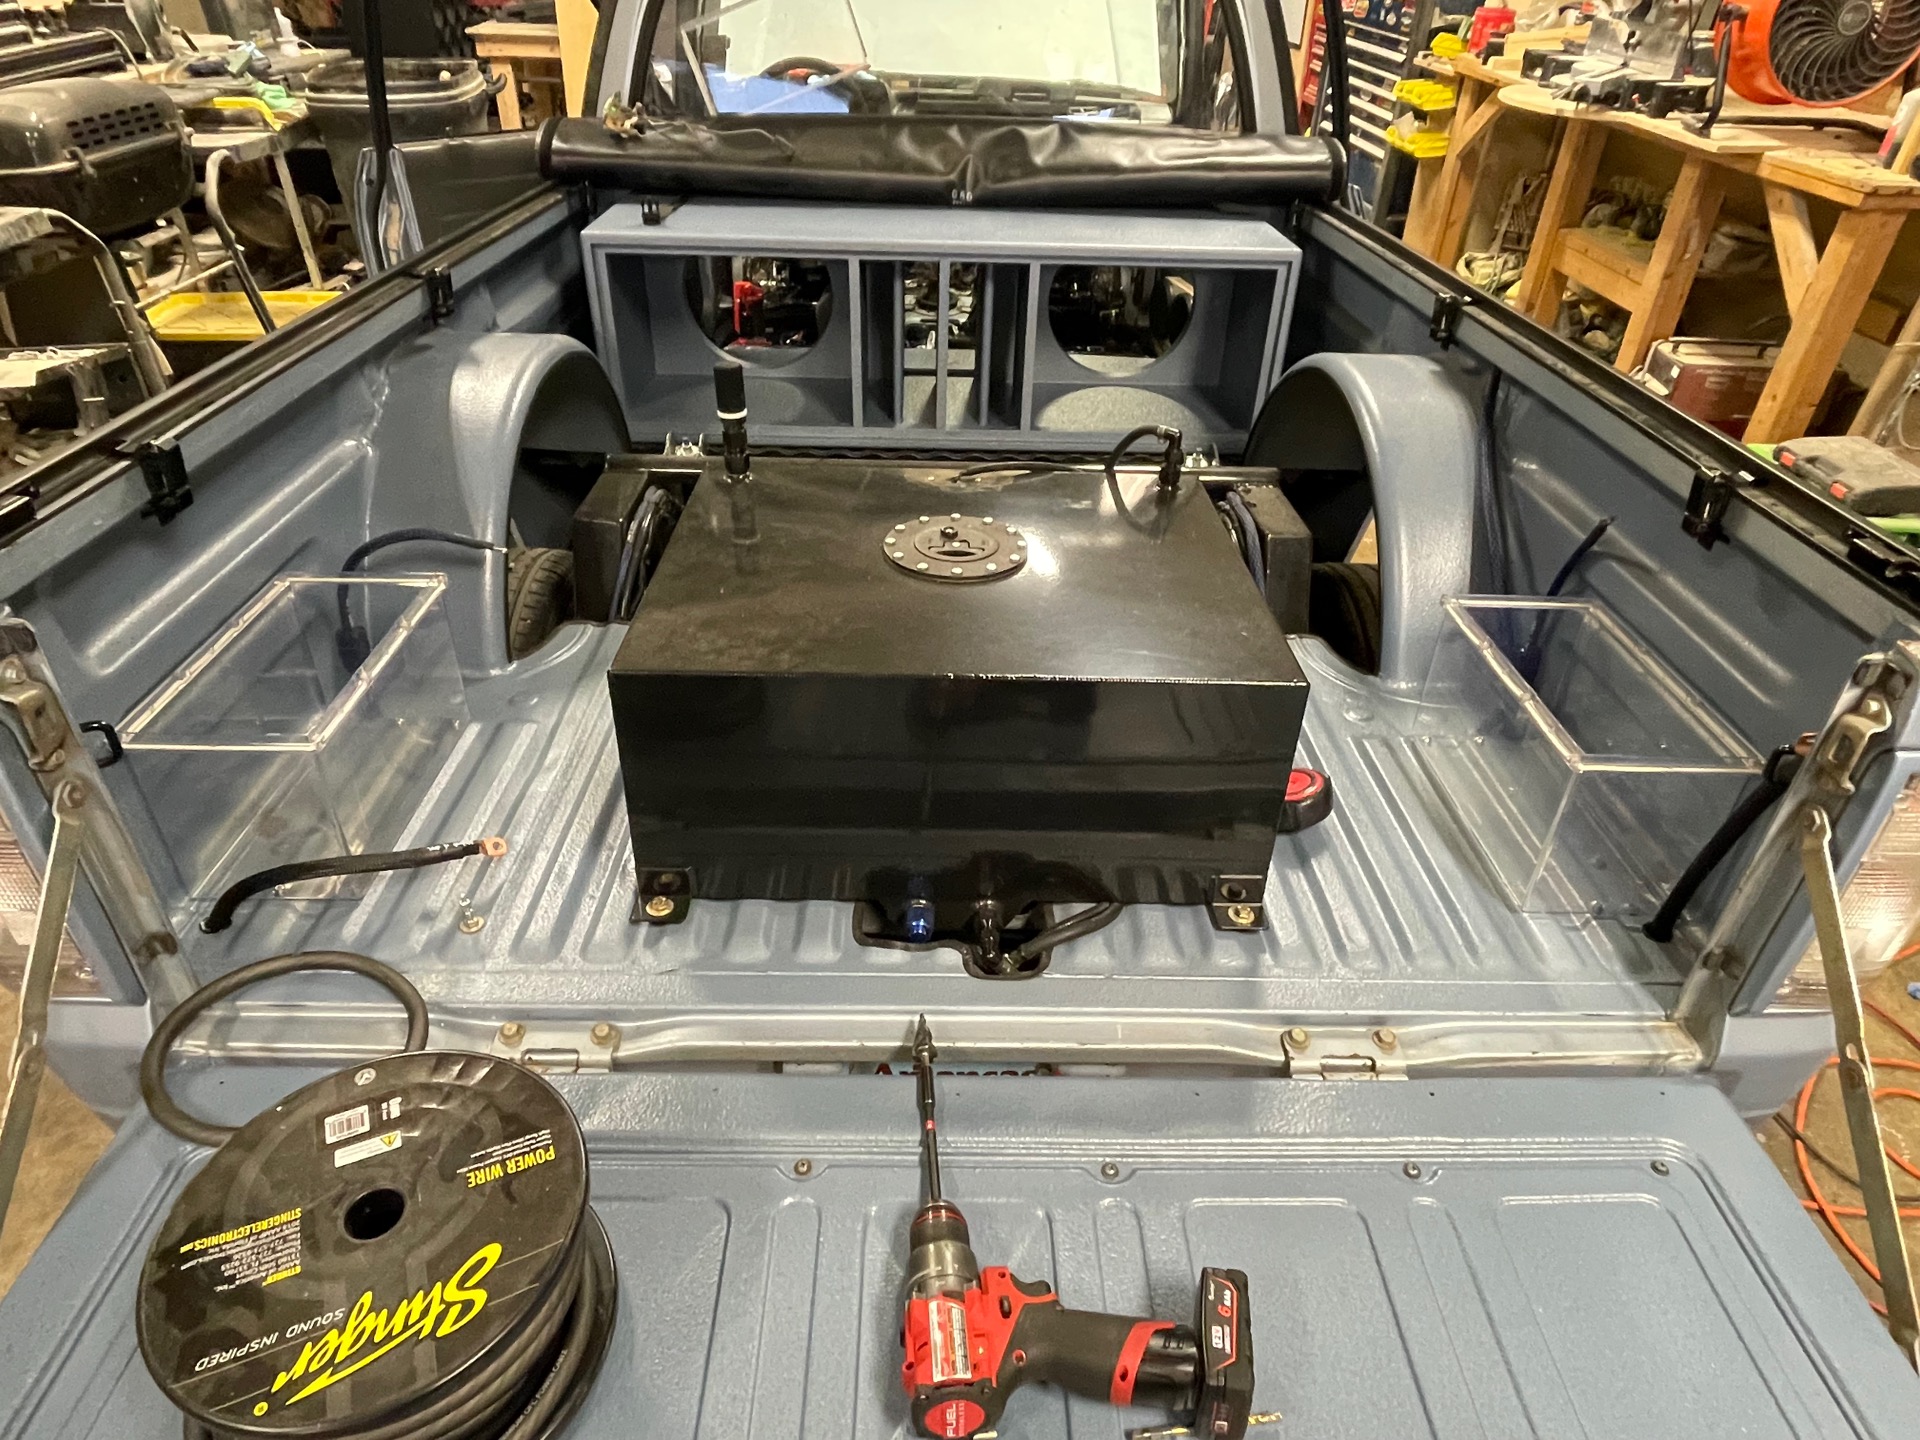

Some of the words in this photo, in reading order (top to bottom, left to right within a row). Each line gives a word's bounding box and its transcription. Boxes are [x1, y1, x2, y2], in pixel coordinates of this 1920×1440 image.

[467, 1163, 504, 1188] WIRE
[506, 1146, 556, 1173] POWER
[271, 1242, 503, 1405] Stinger
[285, 1307, 346, 1339] SOUND
[194, 1332, 279, 1372] INSPIRED
[946, 1403, 957, 1437] FUEL
